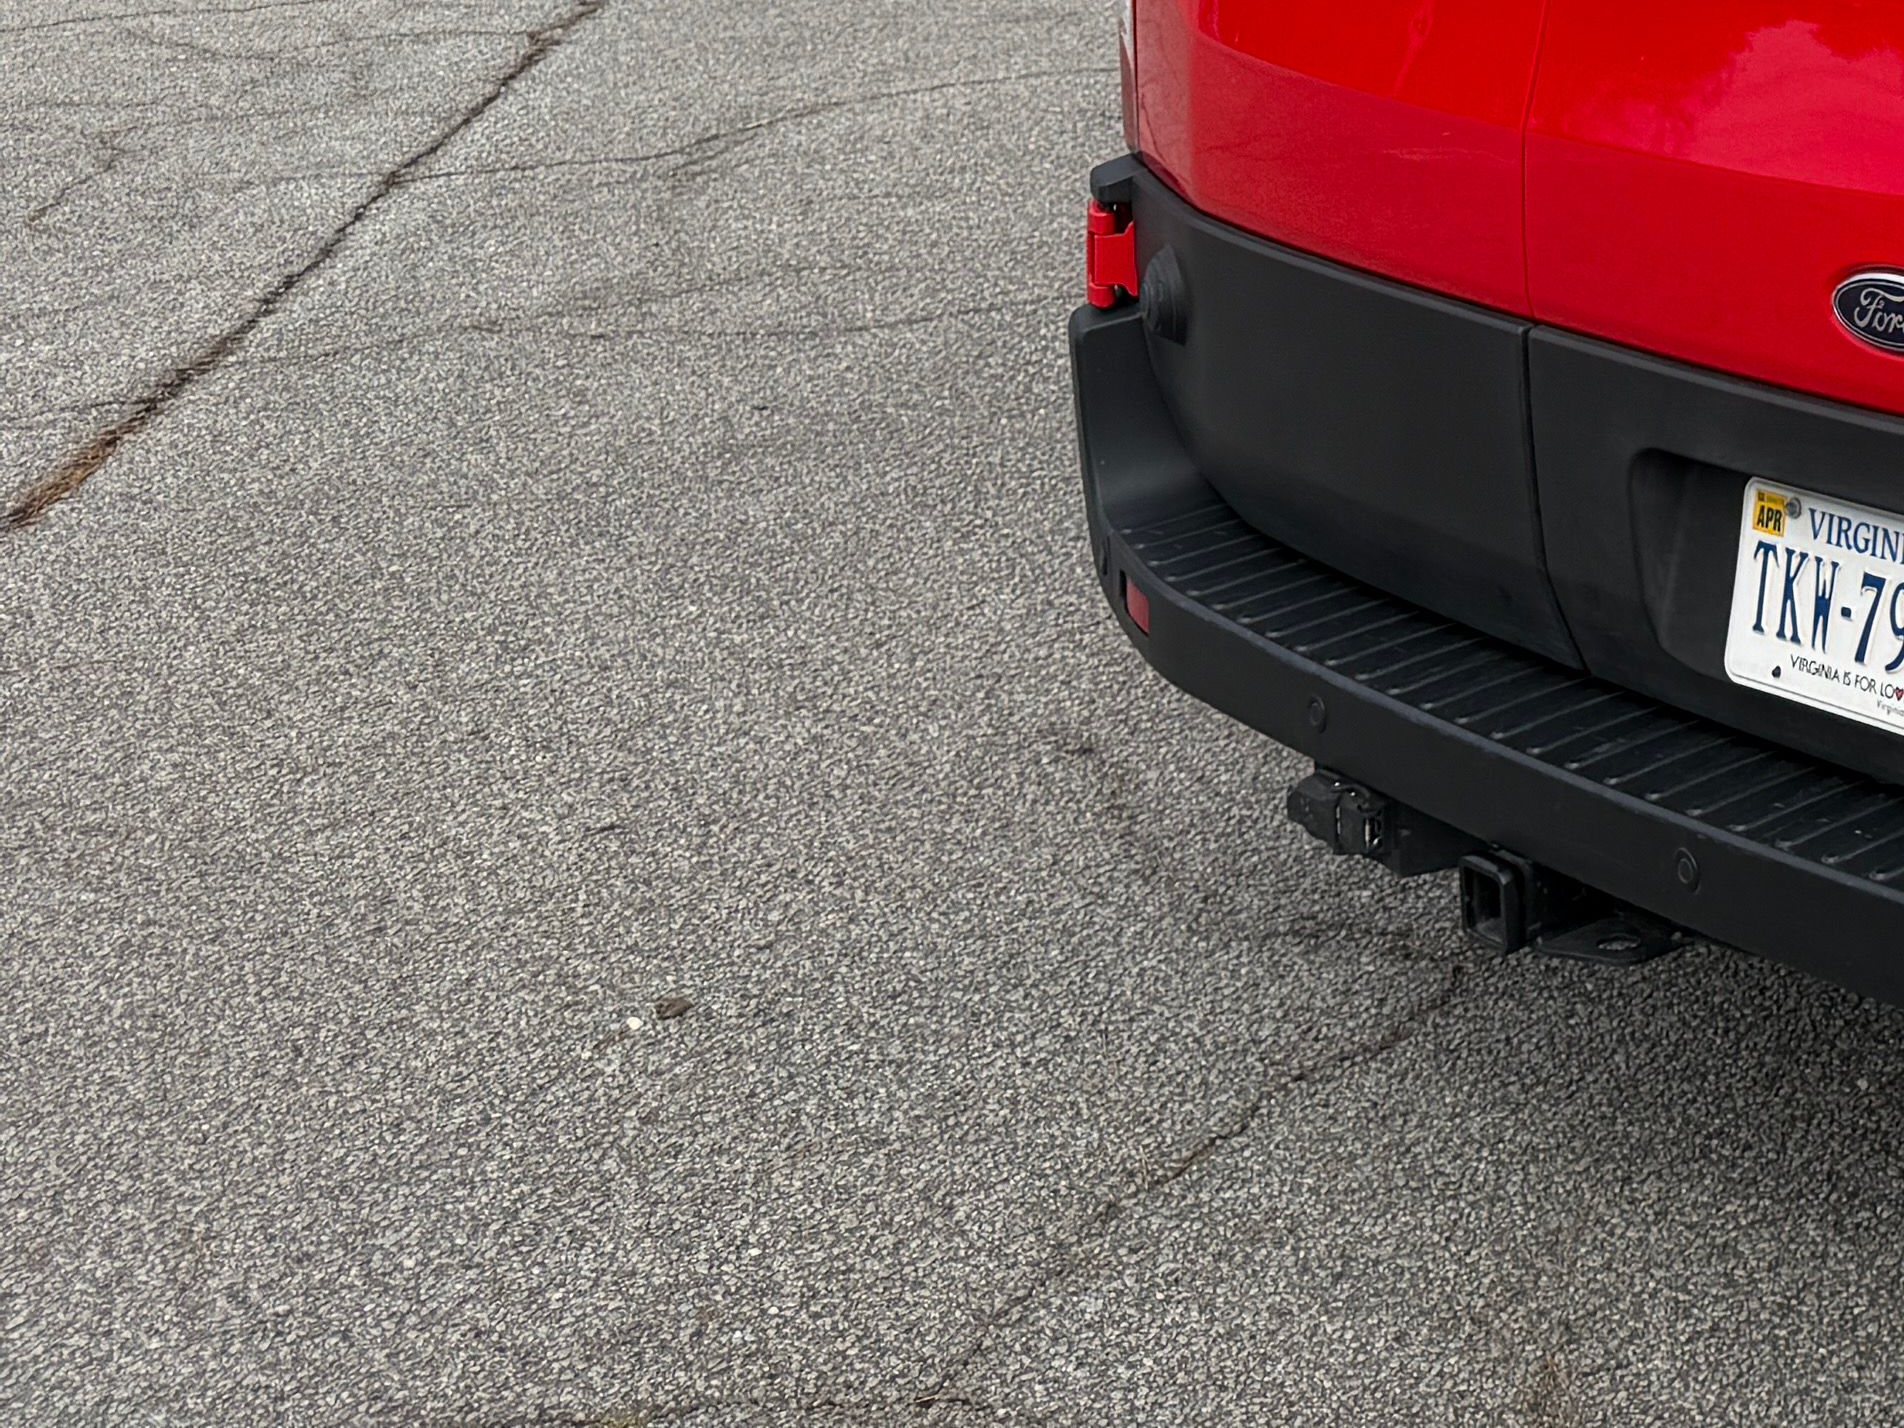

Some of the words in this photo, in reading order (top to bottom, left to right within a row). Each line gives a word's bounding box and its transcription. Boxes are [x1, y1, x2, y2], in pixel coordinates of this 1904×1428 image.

[1756, 504, 1783, 532] APR
[1790, 653, 1840, 683] VIRGINIA
[1842, 671, 1852, 686] IS
[1854, 674, 1877, 694] FOR
